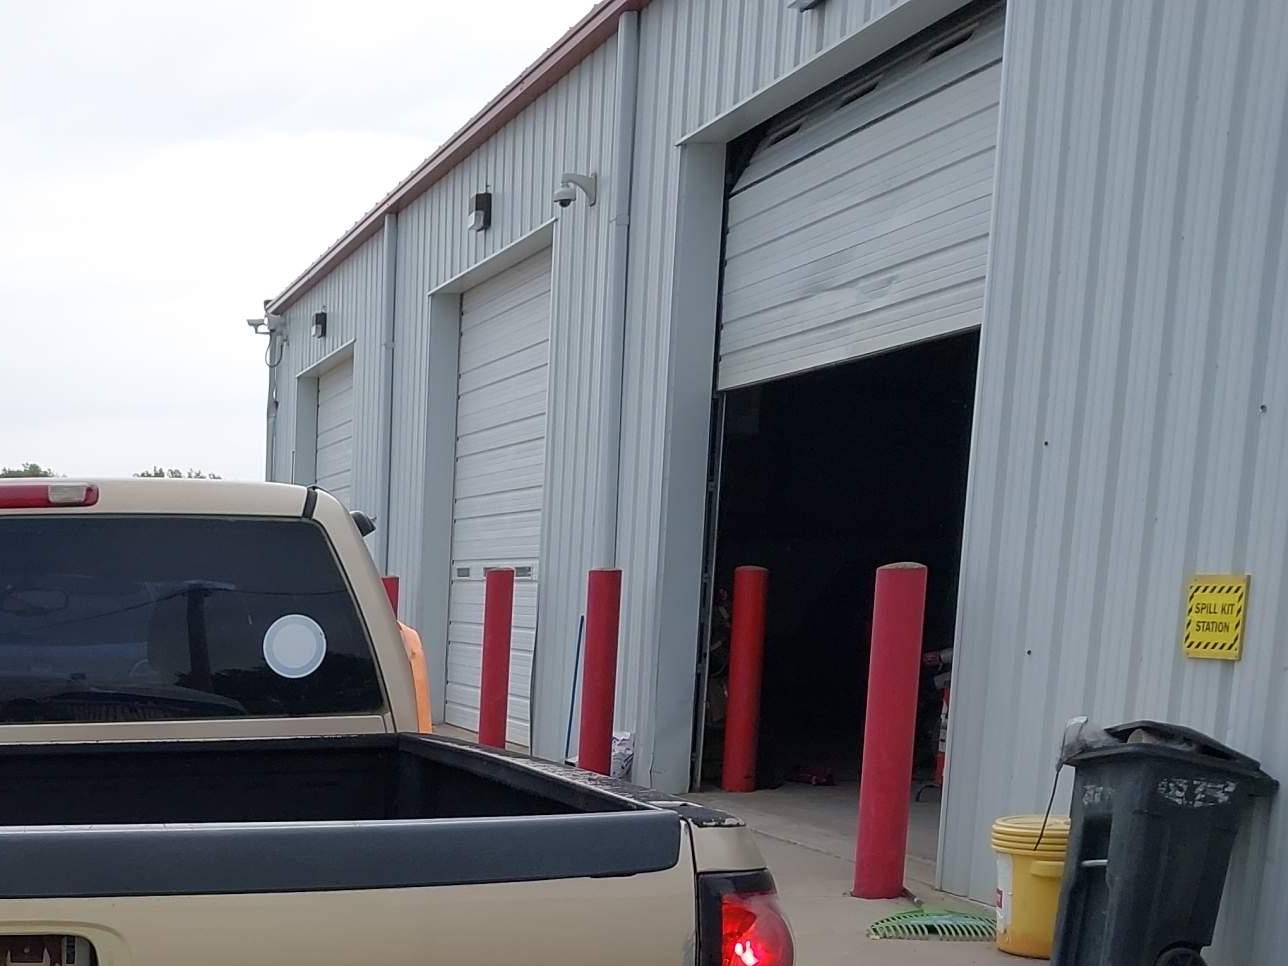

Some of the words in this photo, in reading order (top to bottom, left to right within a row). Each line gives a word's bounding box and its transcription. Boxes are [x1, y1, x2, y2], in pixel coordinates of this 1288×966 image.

[1194, 603, 1218, 614] SPILL
[1221, 603, 1235, 615] KIT
[1195, 621, 1229, 632] STATION
